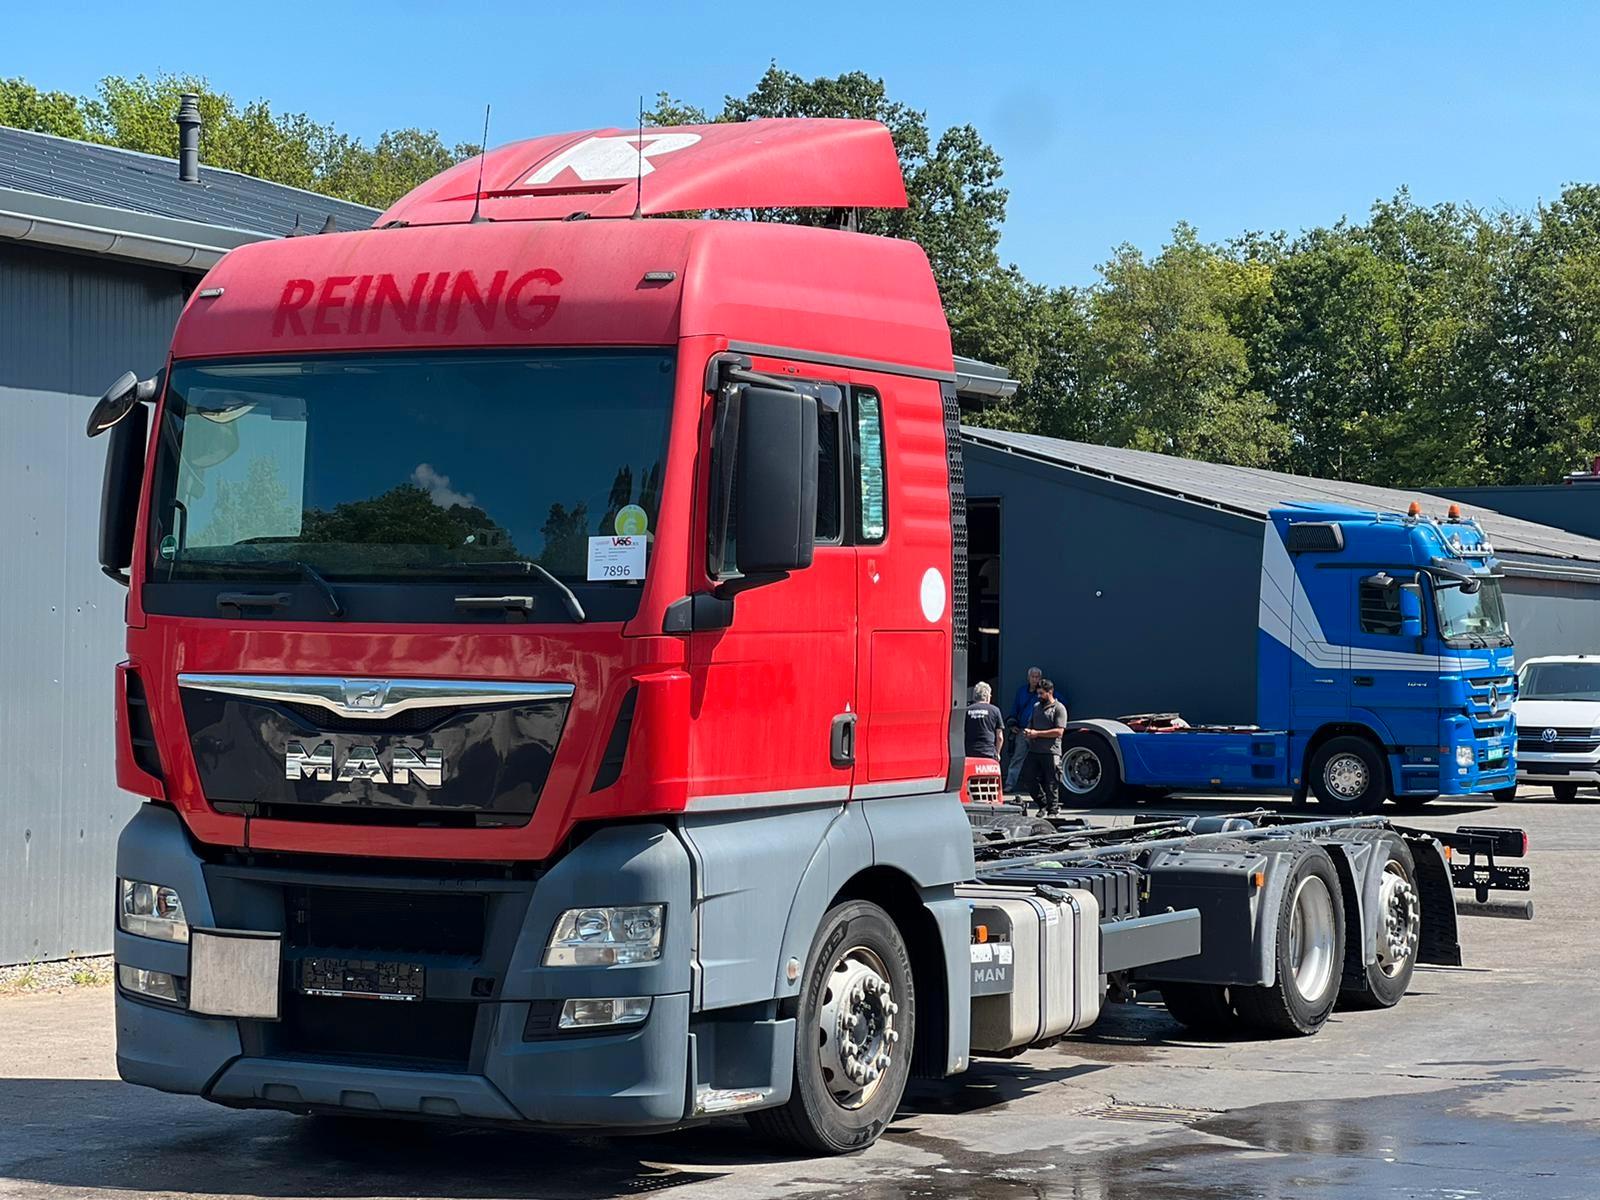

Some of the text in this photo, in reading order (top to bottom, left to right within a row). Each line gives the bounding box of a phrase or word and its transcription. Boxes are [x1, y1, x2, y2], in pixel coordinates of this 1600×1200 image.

[272, 268, 564, 337] REINING
[603, 565, 630, 577] 7896
[286, 741, 443, 789] MAN
[974, 967, 1006, 982] MAN
